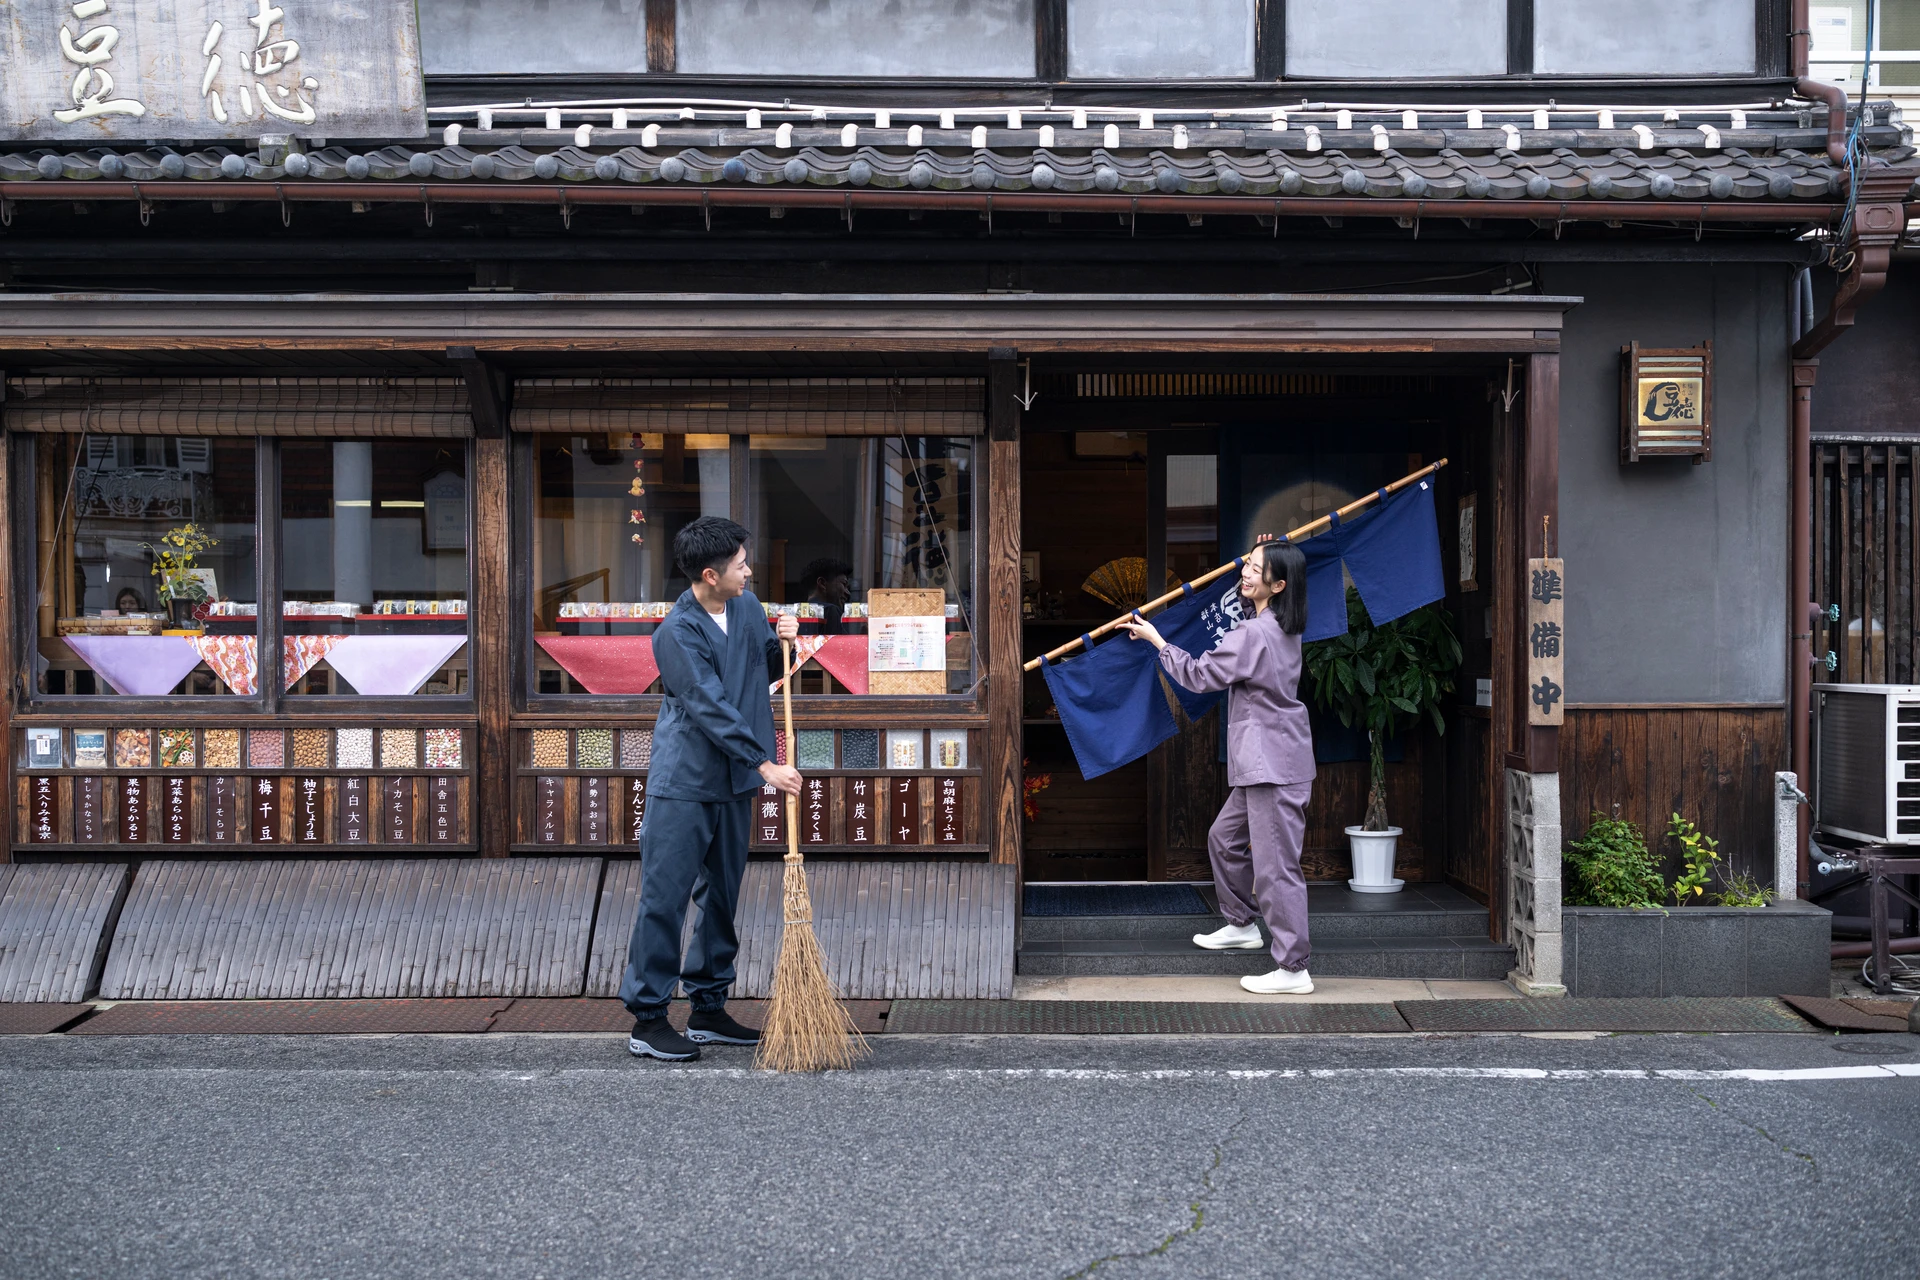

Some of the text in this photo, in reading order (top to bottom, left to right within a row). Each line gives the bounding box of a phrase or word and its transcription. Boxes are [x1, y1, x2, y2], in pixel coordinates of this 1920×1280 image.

[52, 0, 319, 125] 豆徳
[1530, 568, 1562, 715] 準備中
[37, 777, 52, 840] 黒五入りみそ南京
[127, 778, 140, 841] 果物あらかると
[170, 778, 184, 841] 野菜あらかると
[215, 777, 225, 840] カレーそら豆
[258, 778, 273, 841] 梅干豆
[302, 778, 317, 841] 柚子こしょう豆
[347, 778, 360, 841] 紅白大豆
[393, 777, 404, 840] イカそら豆
[438, 777, 448, 840] 田舎五色豆
[544, 777, 555, 841] キャラメル豆
[589, 777, 598, 841] 伊勢あおさ豆
[632, 779, 644, 841] あんころ豆
[808, 779, 823, 842] 抹茶みるく豆
[854, 780, 867, 842] 竹炭豆
[899, 778, 911, 841] ゴーヤ
[943, 778, 956, 841] 白胡麻とうふ豆
